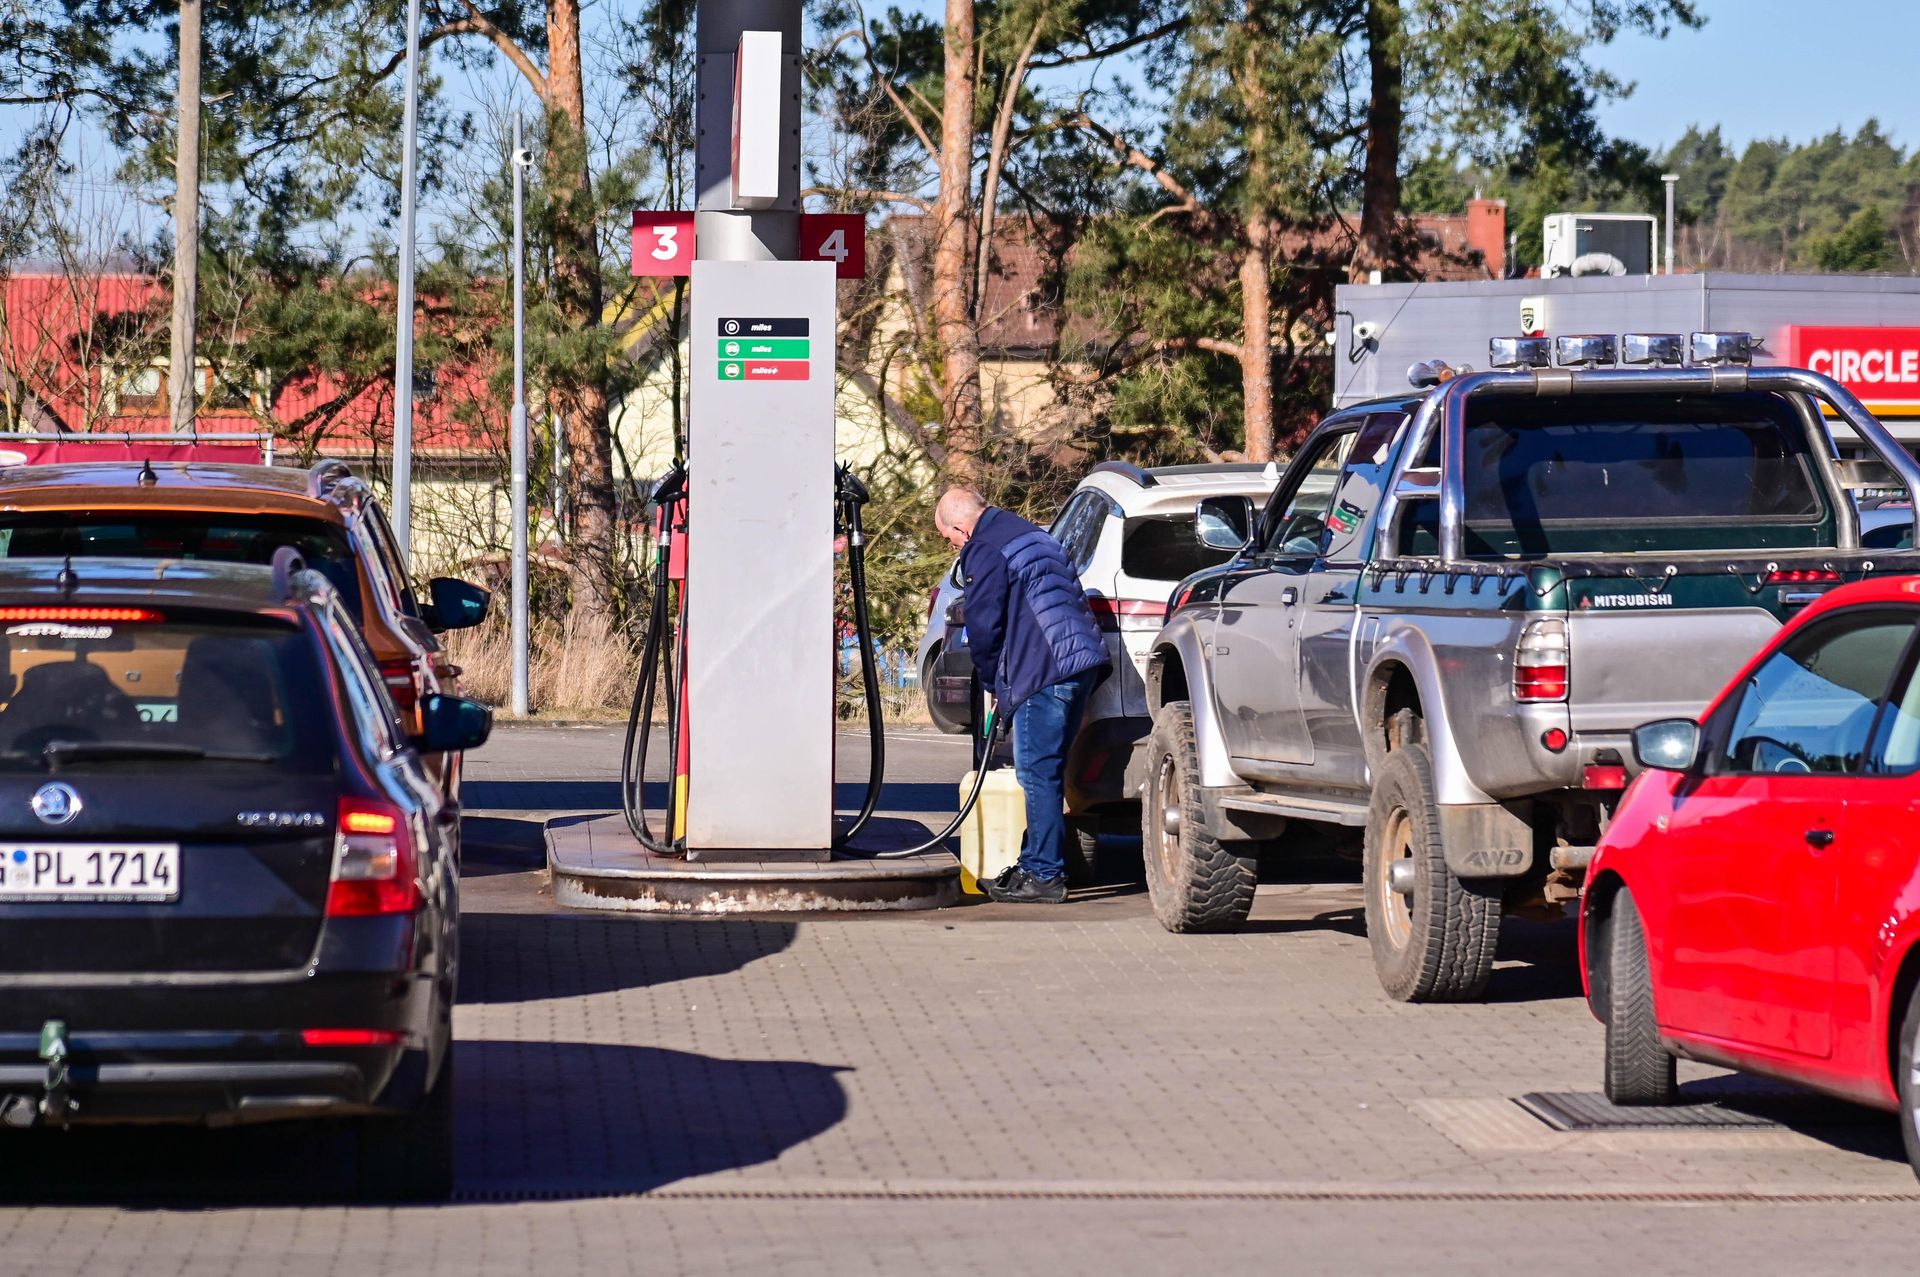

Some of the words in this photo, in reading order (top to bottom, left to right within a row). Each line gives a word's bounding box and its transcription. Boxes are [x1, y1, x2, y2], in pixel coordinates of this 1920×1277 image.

[651, 226, 678, 260] 3
[818, 229, 848, 262] 4
[751, 323, 772, 331] miles
[1808, 350, 1918, 383] CIRCLE
[1594, 594, 1672, 607] MITSUBISHI
[34, 852, 74, 885] PL
[87, 852, 169, 885] 1714
